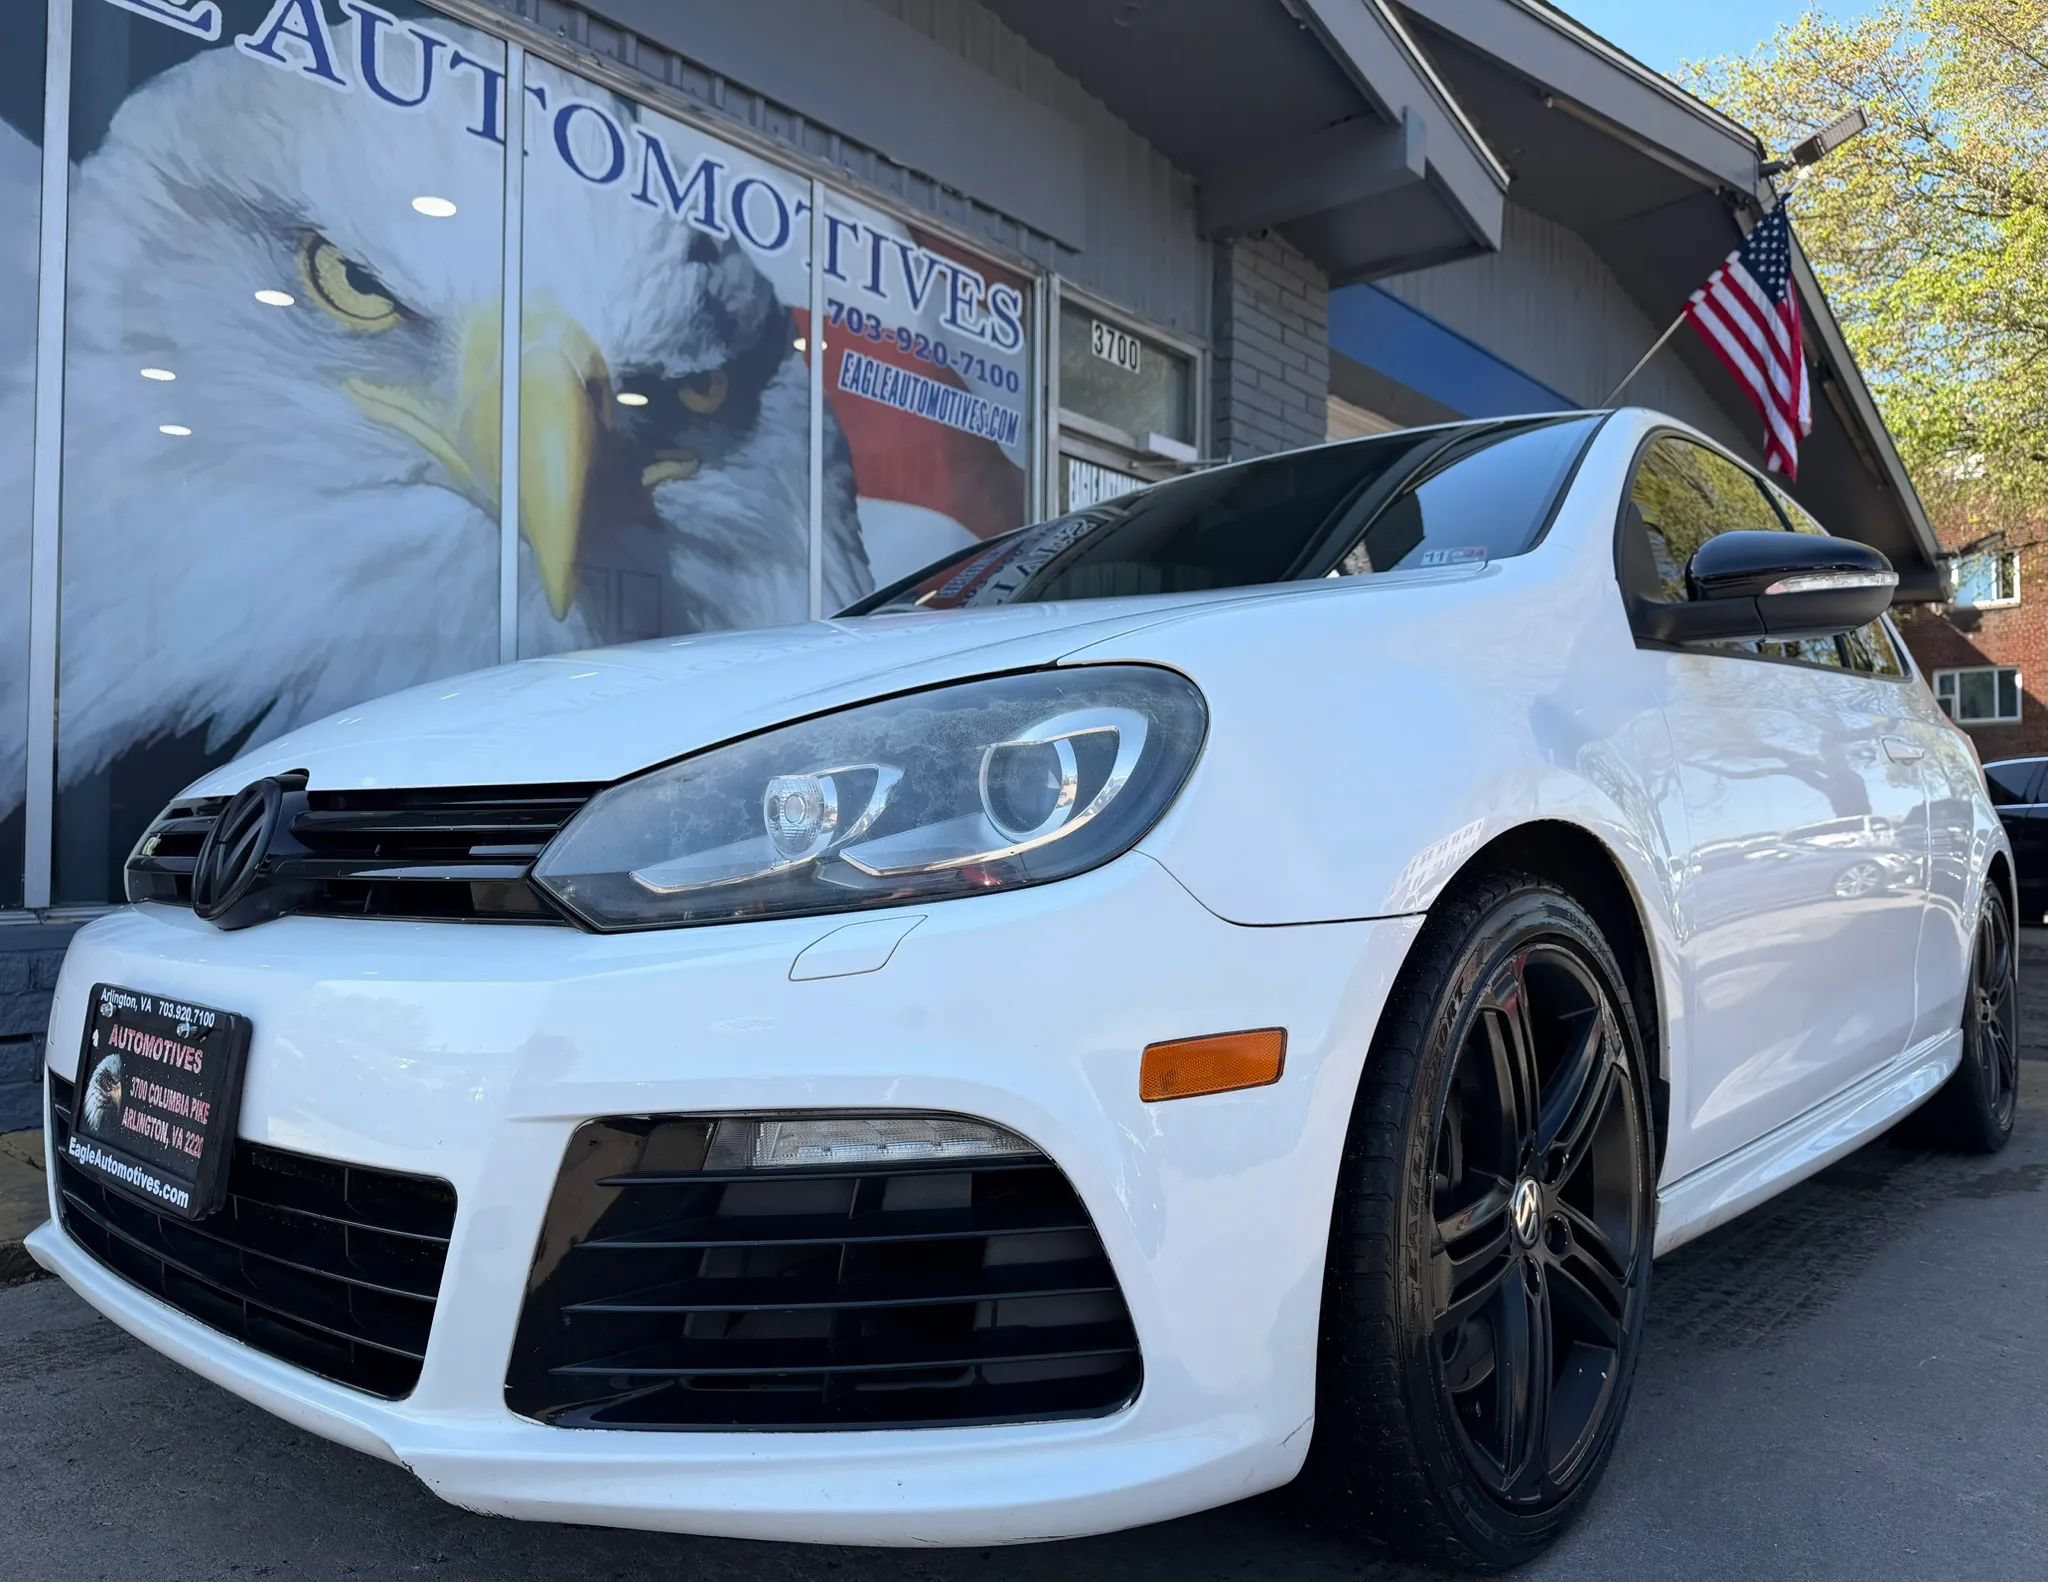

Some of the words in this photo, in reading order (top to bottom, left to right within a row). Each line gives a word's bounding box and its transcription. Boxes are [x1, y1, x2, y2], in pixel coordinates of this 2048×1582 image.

[827, 298, 1019, 393] 703-920-7100
[1094, 324, 1139, 371] 3700
[839, 354, 1020, 444] EAGLEAUTOMOTIVES.COM
[101, 988, 138, 1011] Arlington,
[140, 997, 152, 1013] VA
[158, 1002, 215, 1028] 703.920.7100
[108, 1023, 204, 1075] AUTOMOTIVES
[130, 1076, 149, 1101] 3700
[149, 1083, 190, 1118] COLUMBIA
[190, 1097, 211, 1125] PIKE
[121, 1107, 169, 1149] ARLINGTON,
[172, 1125, 184, 1150] VA
[69, 1136, 189, 1209] EagleAutomotives.com
